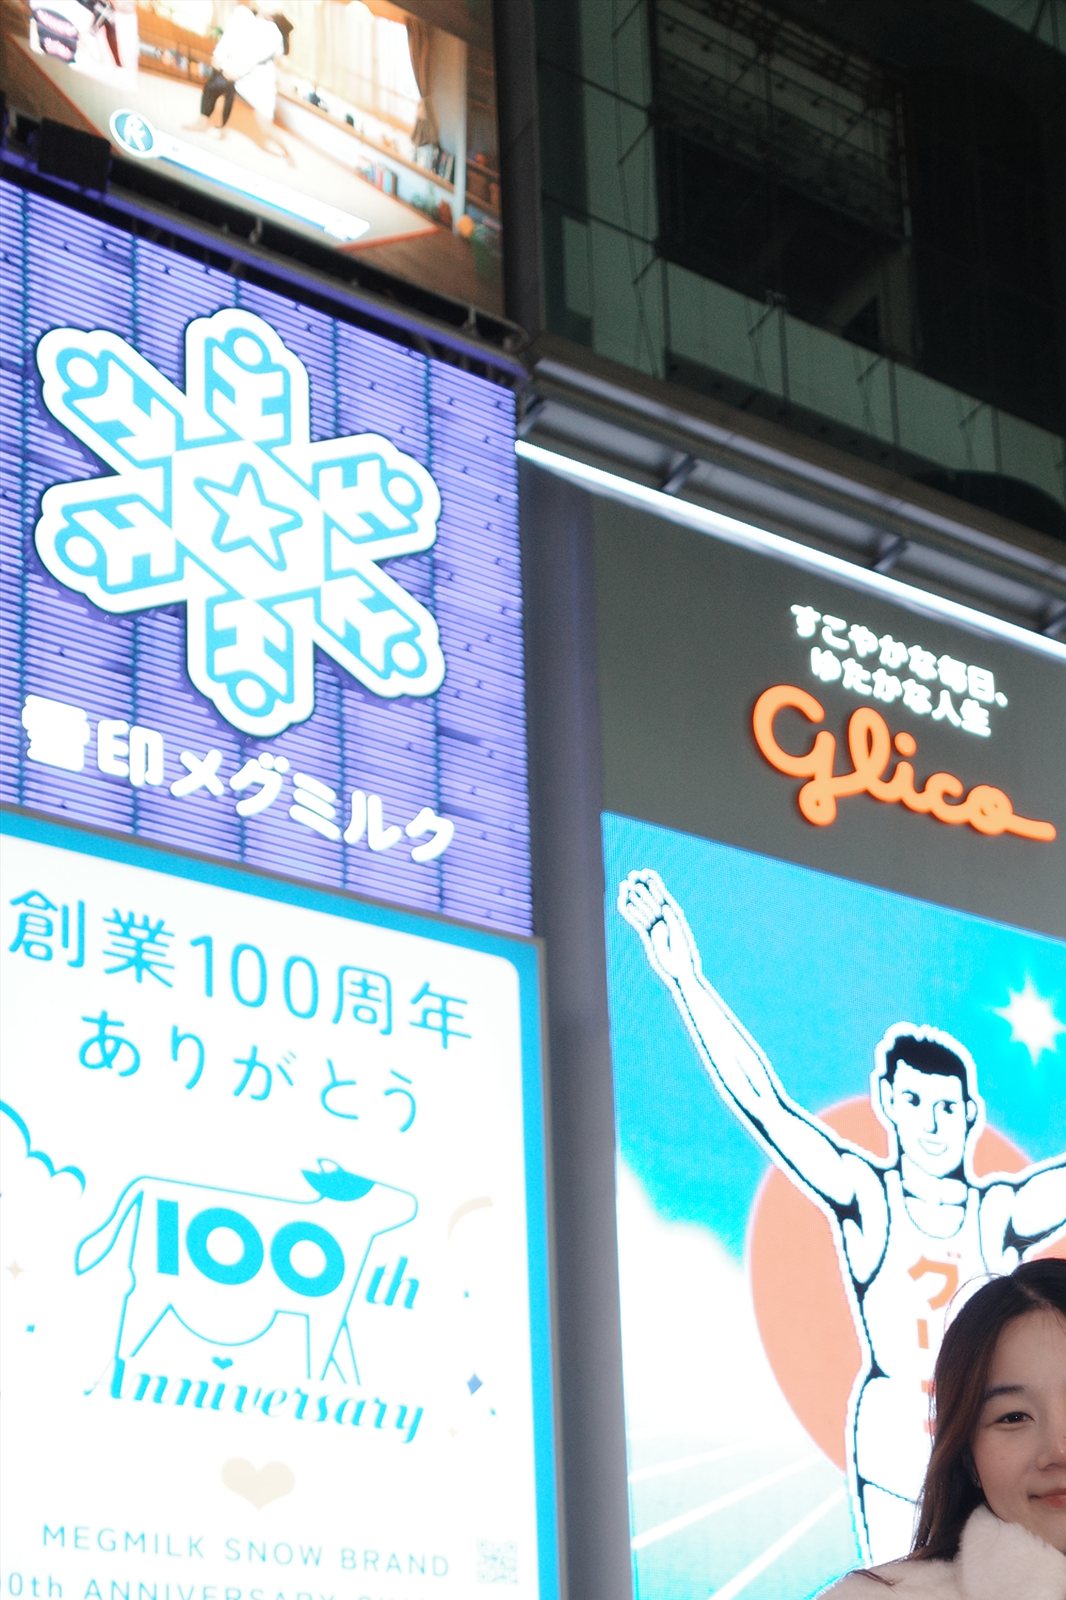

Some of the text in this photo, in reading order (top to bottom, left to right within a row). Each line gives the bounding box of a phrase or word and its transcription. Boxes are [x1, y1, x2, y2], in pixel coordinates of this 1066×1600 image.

[810, 646, 992, 738] ゆたかな人生
[21, 694, 455, 863] 雪印メグミルク
[751, 684, 1057, 841] Glico
[9, 889, 472, 1050] 創業100周年
[79, 1010, 416, 1133] ありがとう
[84, 1356, 424, 1444] Anniversary
[0, 1571, 62, 1599] 0th
[43, 1524, 450, 1577] MEGMILK SNOW BRAND
